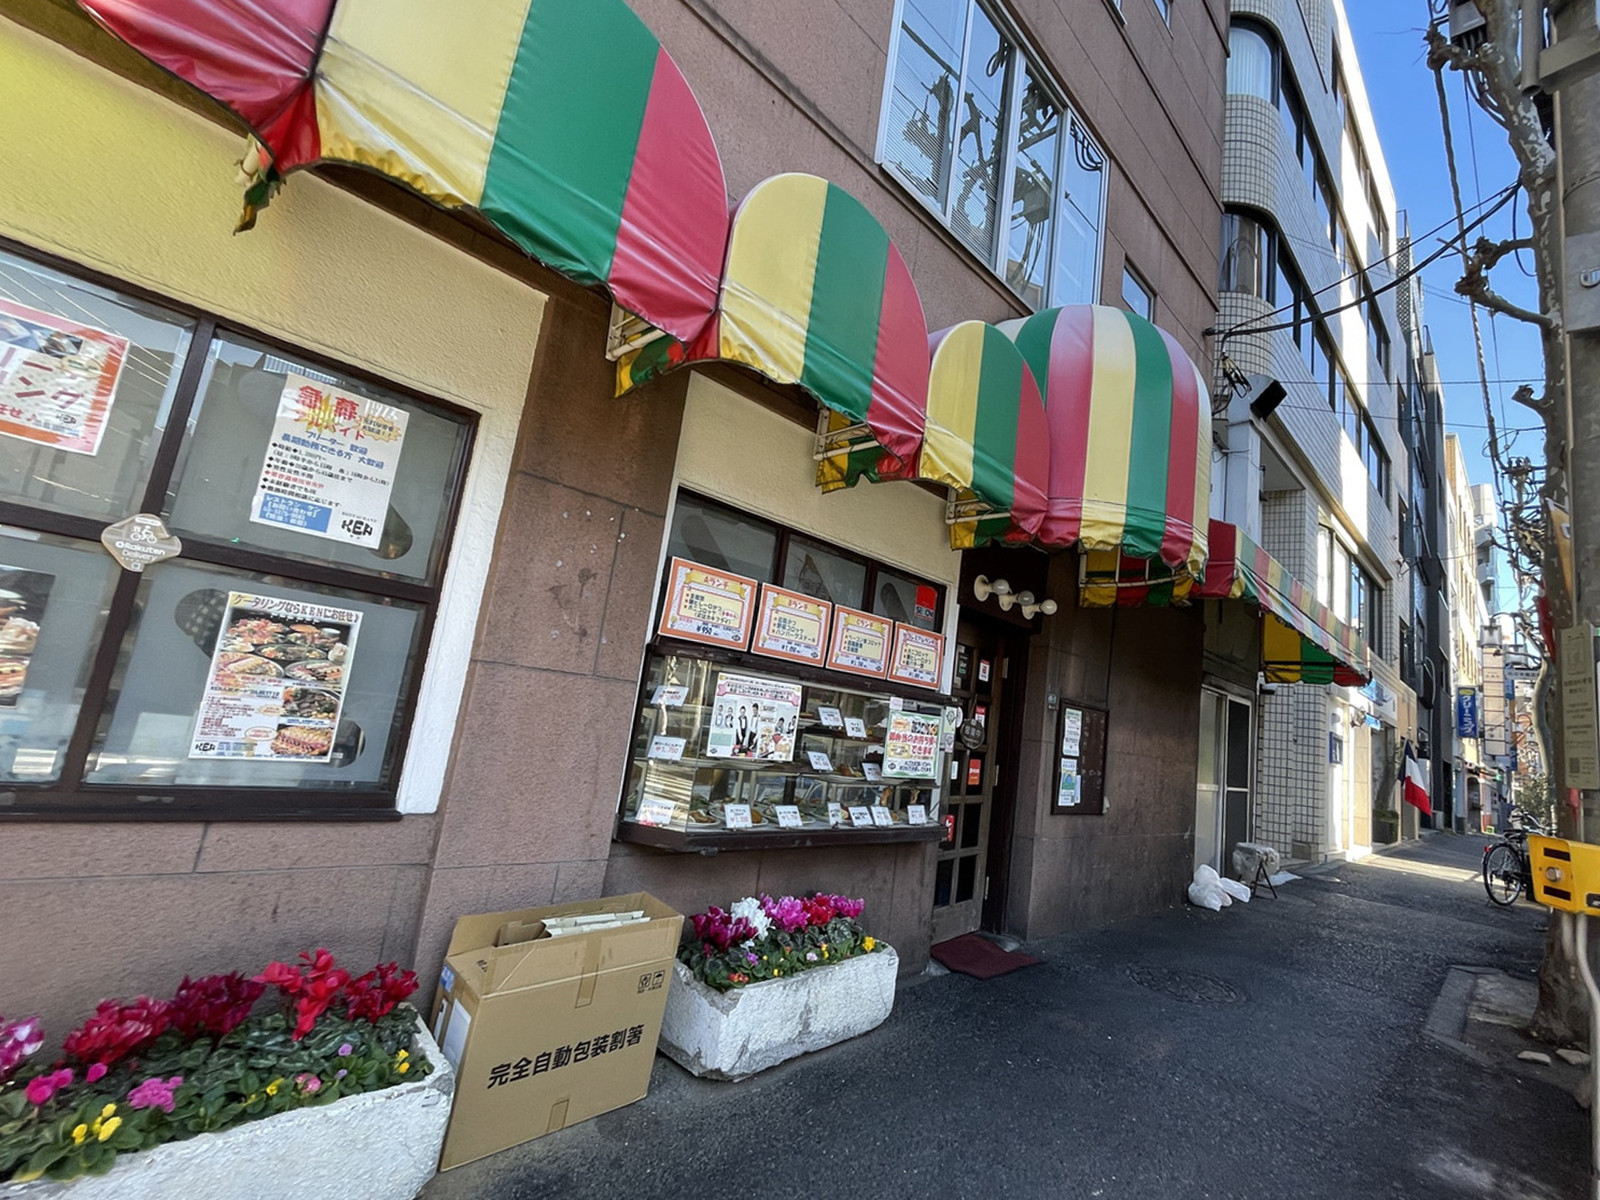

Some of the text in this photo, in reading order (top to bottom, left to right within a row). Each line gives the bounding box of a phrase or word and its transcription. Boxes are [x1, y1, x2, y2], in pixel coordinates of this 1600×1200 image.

[294, 383, 360, 422] 急募
[280, 432, 384, 469] 長期勤務できる方 大歓迎
[305, 430, 368, 455] フリーター 歓迎
[124, 543, 165, 556] Rakuten
[487, 1024, 645, 1090] 完全自動包装割箸
